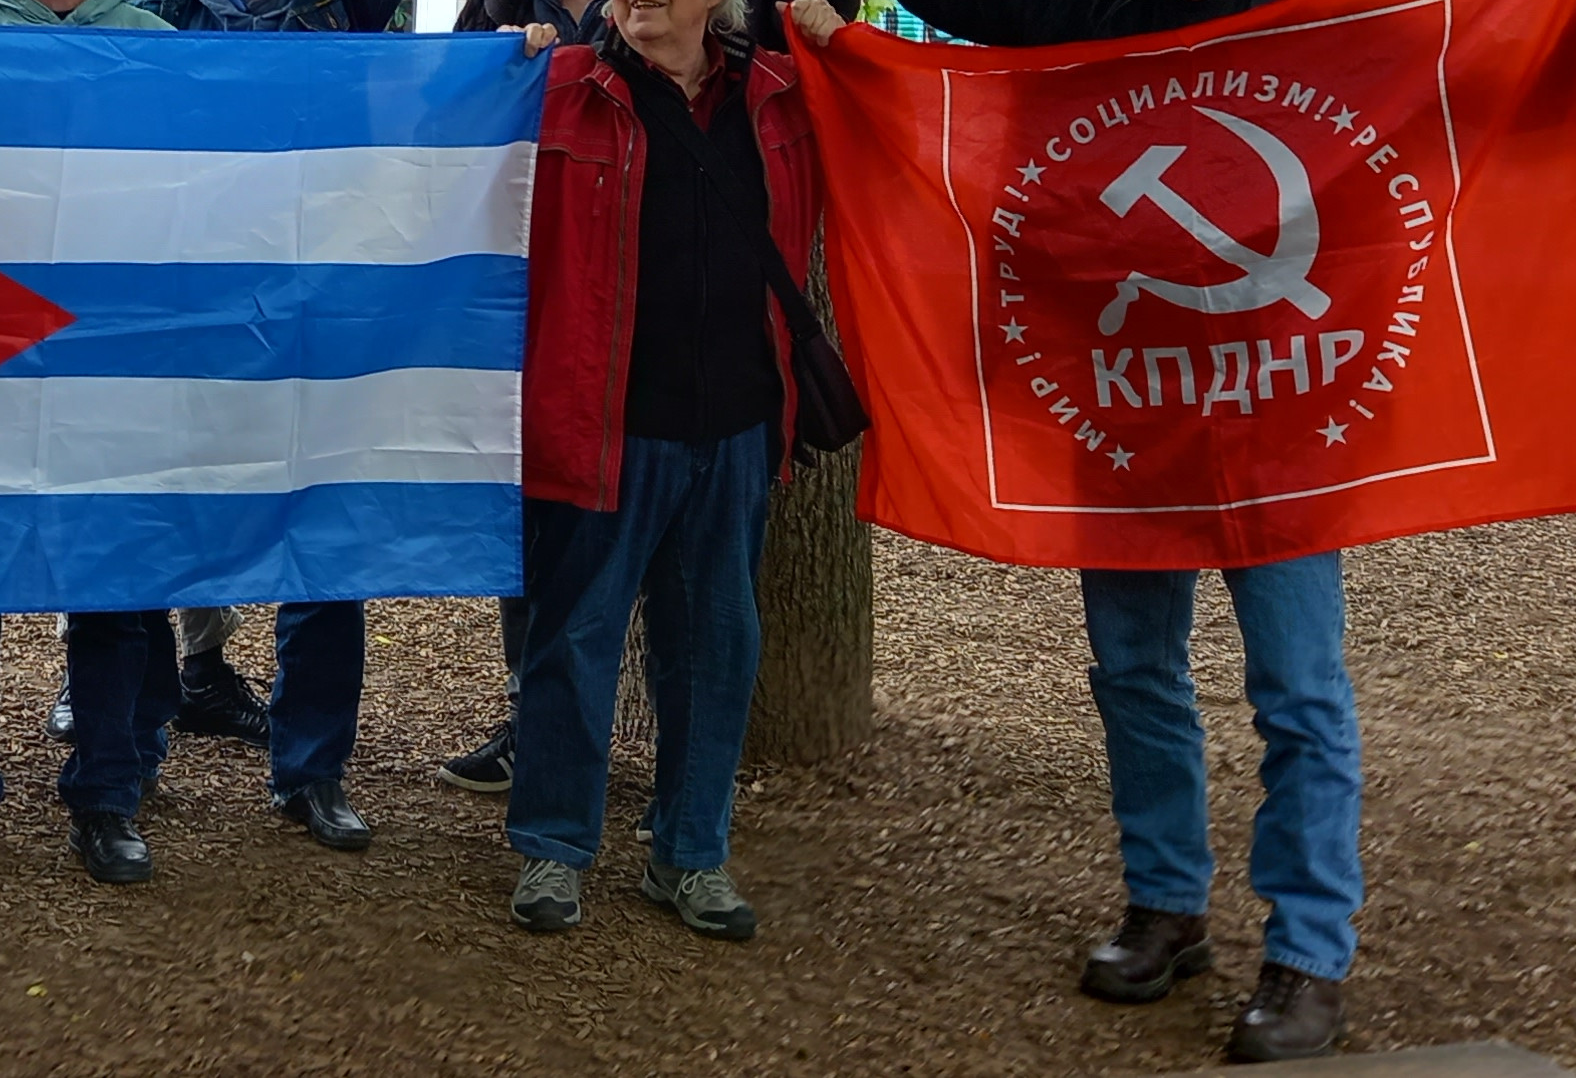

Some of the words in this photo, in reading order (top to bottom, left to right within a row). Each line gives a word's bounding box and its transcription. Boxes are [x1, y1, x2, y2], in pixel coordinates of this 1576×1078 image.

[1046, 71, 1335, 162] СОЦИАЛИЗМ!
[992, 185, 1029, 307] ТРУД!
[1349, 125, 1434, 420] РЕСПУБЛИКА!
[1016, 352, 1106, 451] МИР!
[1091, 329, 1365, 416] КПДНР
